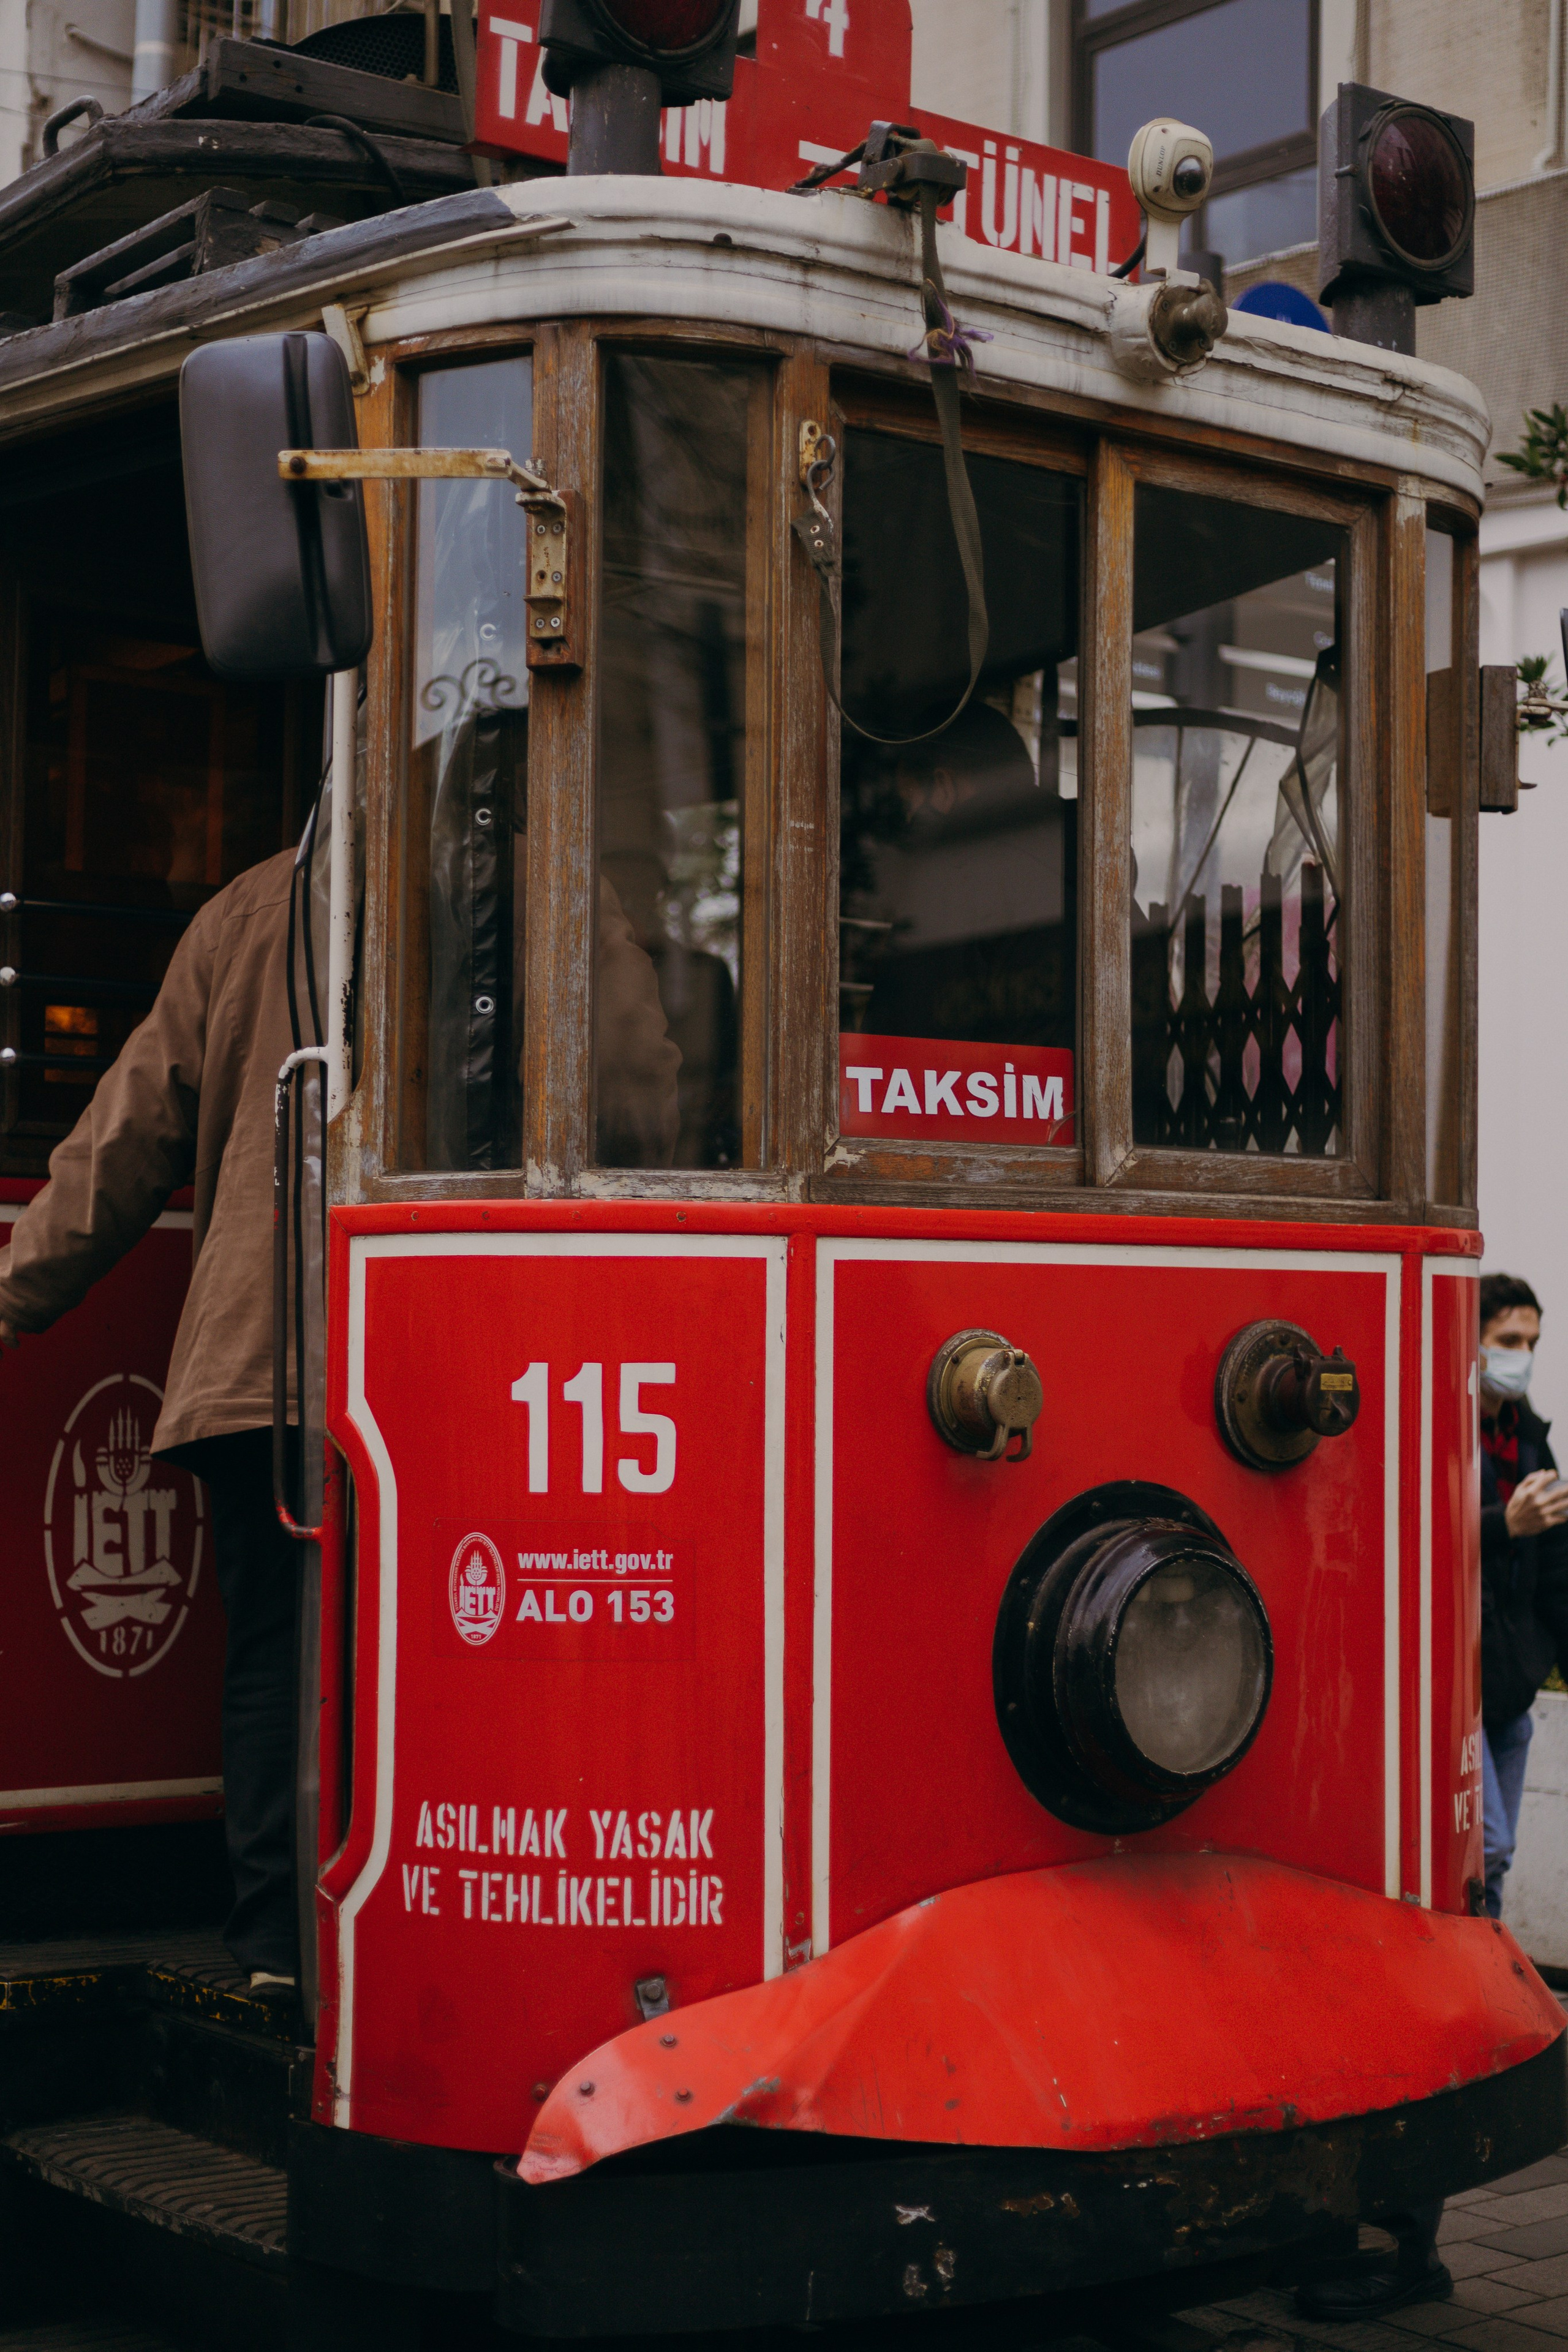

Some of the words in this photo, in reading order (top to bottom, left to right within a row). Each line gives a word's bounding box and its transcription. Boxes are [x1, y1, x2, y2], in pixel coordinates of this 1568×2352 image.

[489, 16, 726, 175] TAM
[943, 139, 1122, 277] TÜNEL
[1156, 145, 1166, 176] DUNLOP
[845, 1062, 1064, 1120] TAKSİM
[511, 1362, 677, 1493] 115
[517, 1548, 674, 1575] www.iett.gov.tr
[515, 1589, 594, 1623] ALO
[607, 1589, 675, 1623] 153
[99, 1626, 153, 1655] 1871
[416, 1801, 568, 1858] ASILMAK
[589, 1809, 714, 1860] YASAK
[1454, 1790, 1470, 1833] VE
[402, 1863, 440, 1916] VE
[458, 1868, 723, 1926] TEHLİKELİDİR
